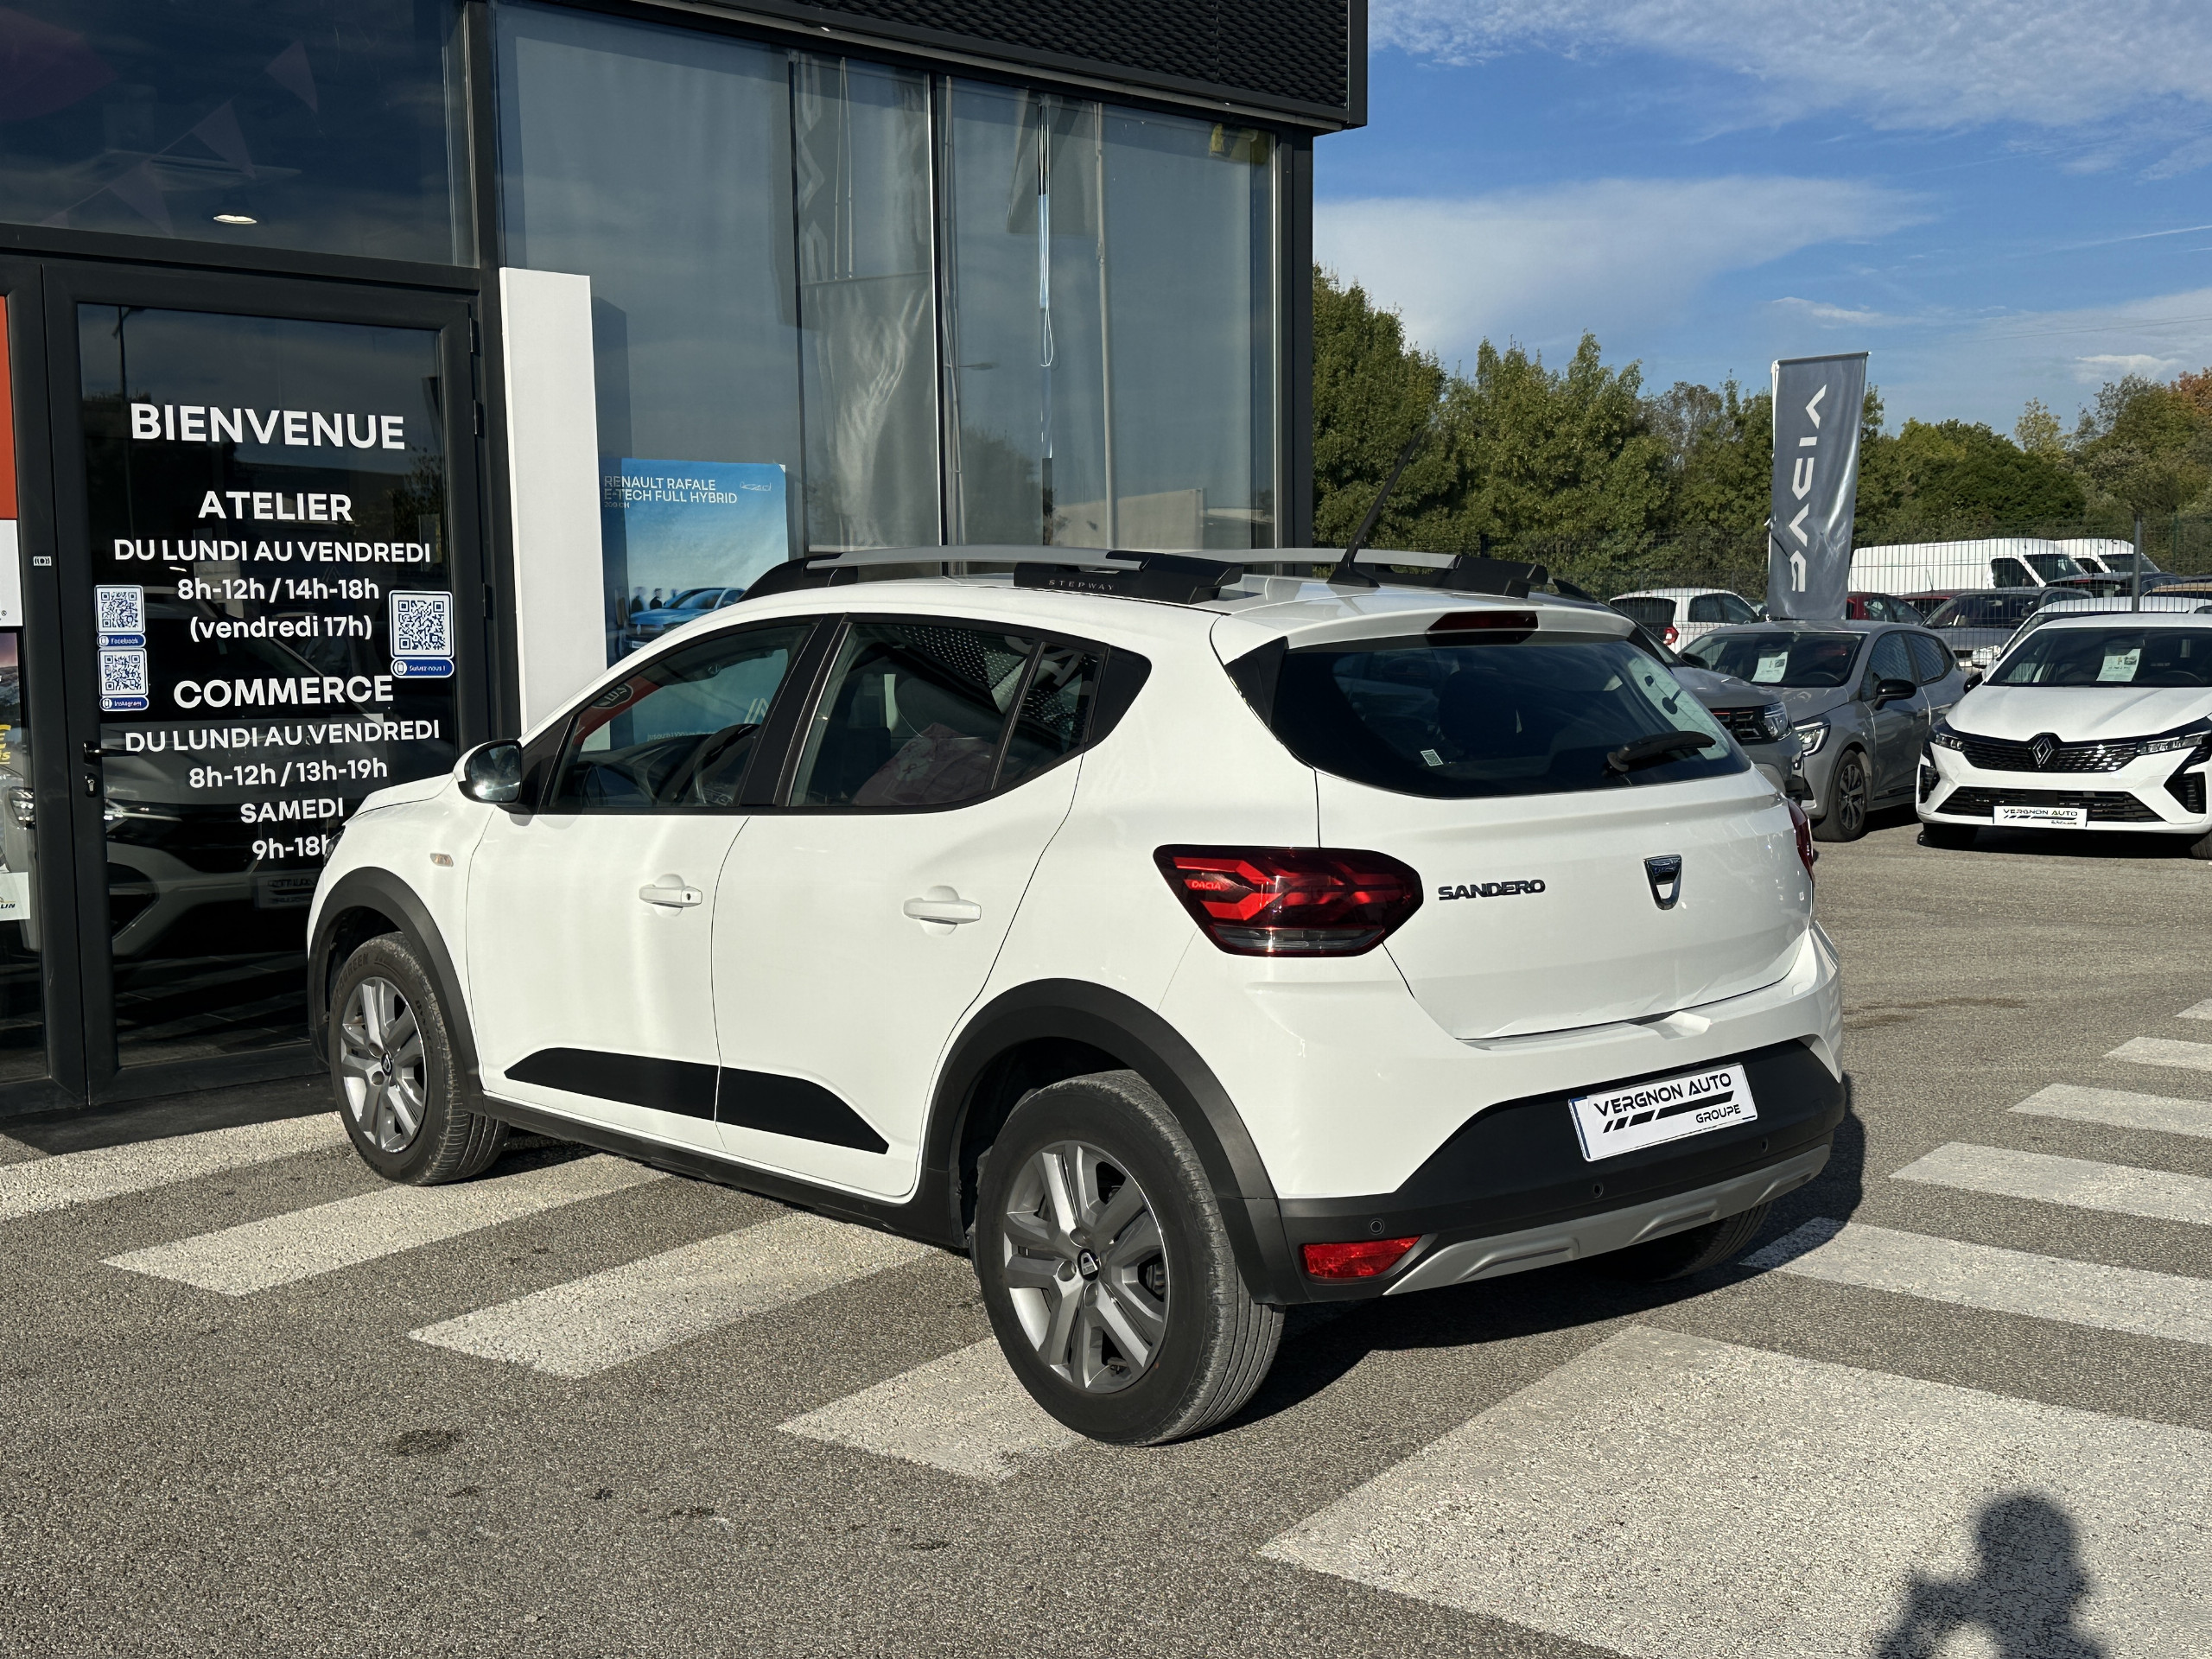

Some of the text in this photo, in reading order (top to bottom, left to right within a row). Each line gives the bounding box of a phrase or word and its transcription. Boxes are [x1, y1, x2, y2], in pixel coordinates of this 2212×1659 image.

[130, 403, 405, 450] BIENVENUE
[604, 476, 715, 491] RENAULT RAFALE
[604, 488, 738, 504] E-TECH FULL HYBRID
[198, 490, 353, 522] ATELIER
[114, 538, 430, 563] DU LUNDI AU VENDREDI
[177, 577, 379, 603] 8h-12h / 14h-18h
[1048, 579, 1114, 591] STEPWAY
[190, 614, 372, 643] (vendredi 17h)
[173, 675, 394, 709] COMMERCE
[124, 720, 440, 753] DU LUNDI AU VENDREDI
[188, 757, 388, 788] 8h-12h / 13h-19h
[240, 797, 344, 823] SAMEDI
[1192, 880, 1222, 891] DACIA
[1438, 879, 1546, 901] SANDERO
[1593, 1072, 1732, 1117] VERGNON AUTO
[1695, 1103, 1741, 1123] GROUPE
